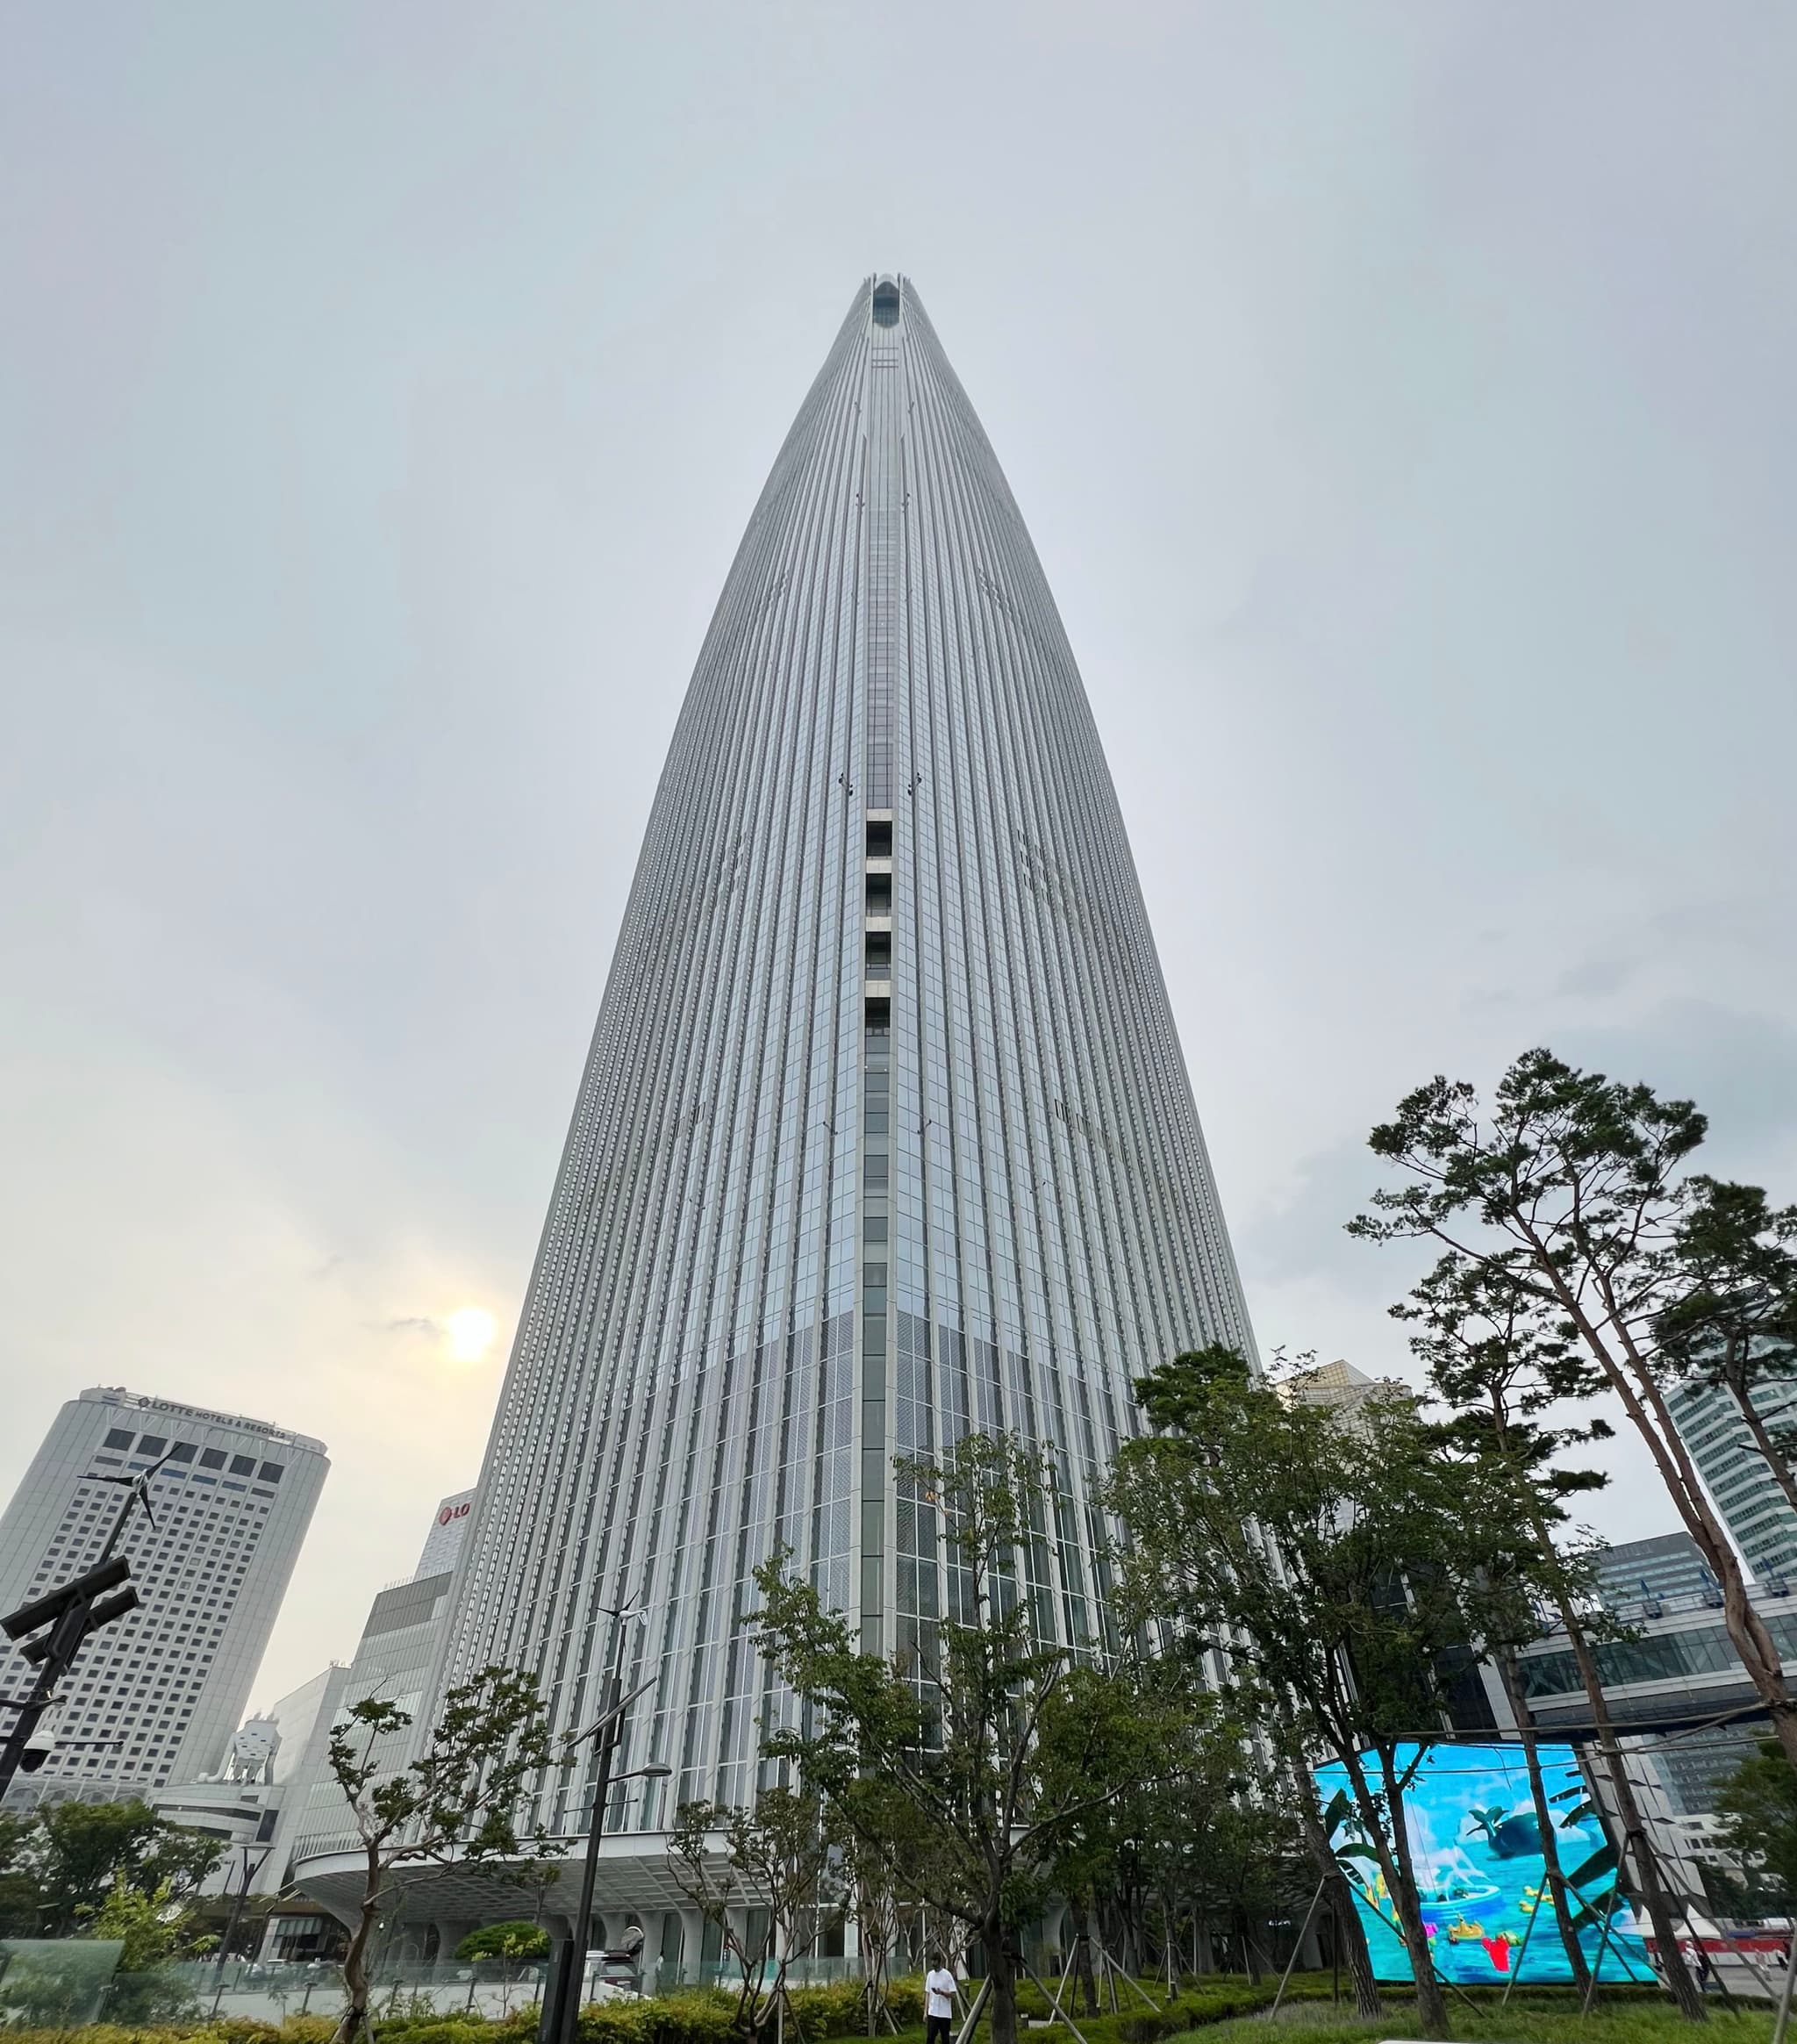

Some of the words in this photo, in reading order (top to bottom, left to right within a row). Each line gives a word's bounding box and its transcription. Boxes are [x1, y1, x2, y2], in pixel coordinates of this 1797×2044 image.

[152, 1400, 194, 1416] LOTTE
[195, 1410, 233, 1425] HOTELS
[243, 1422, 285, 1438] RESORTS
